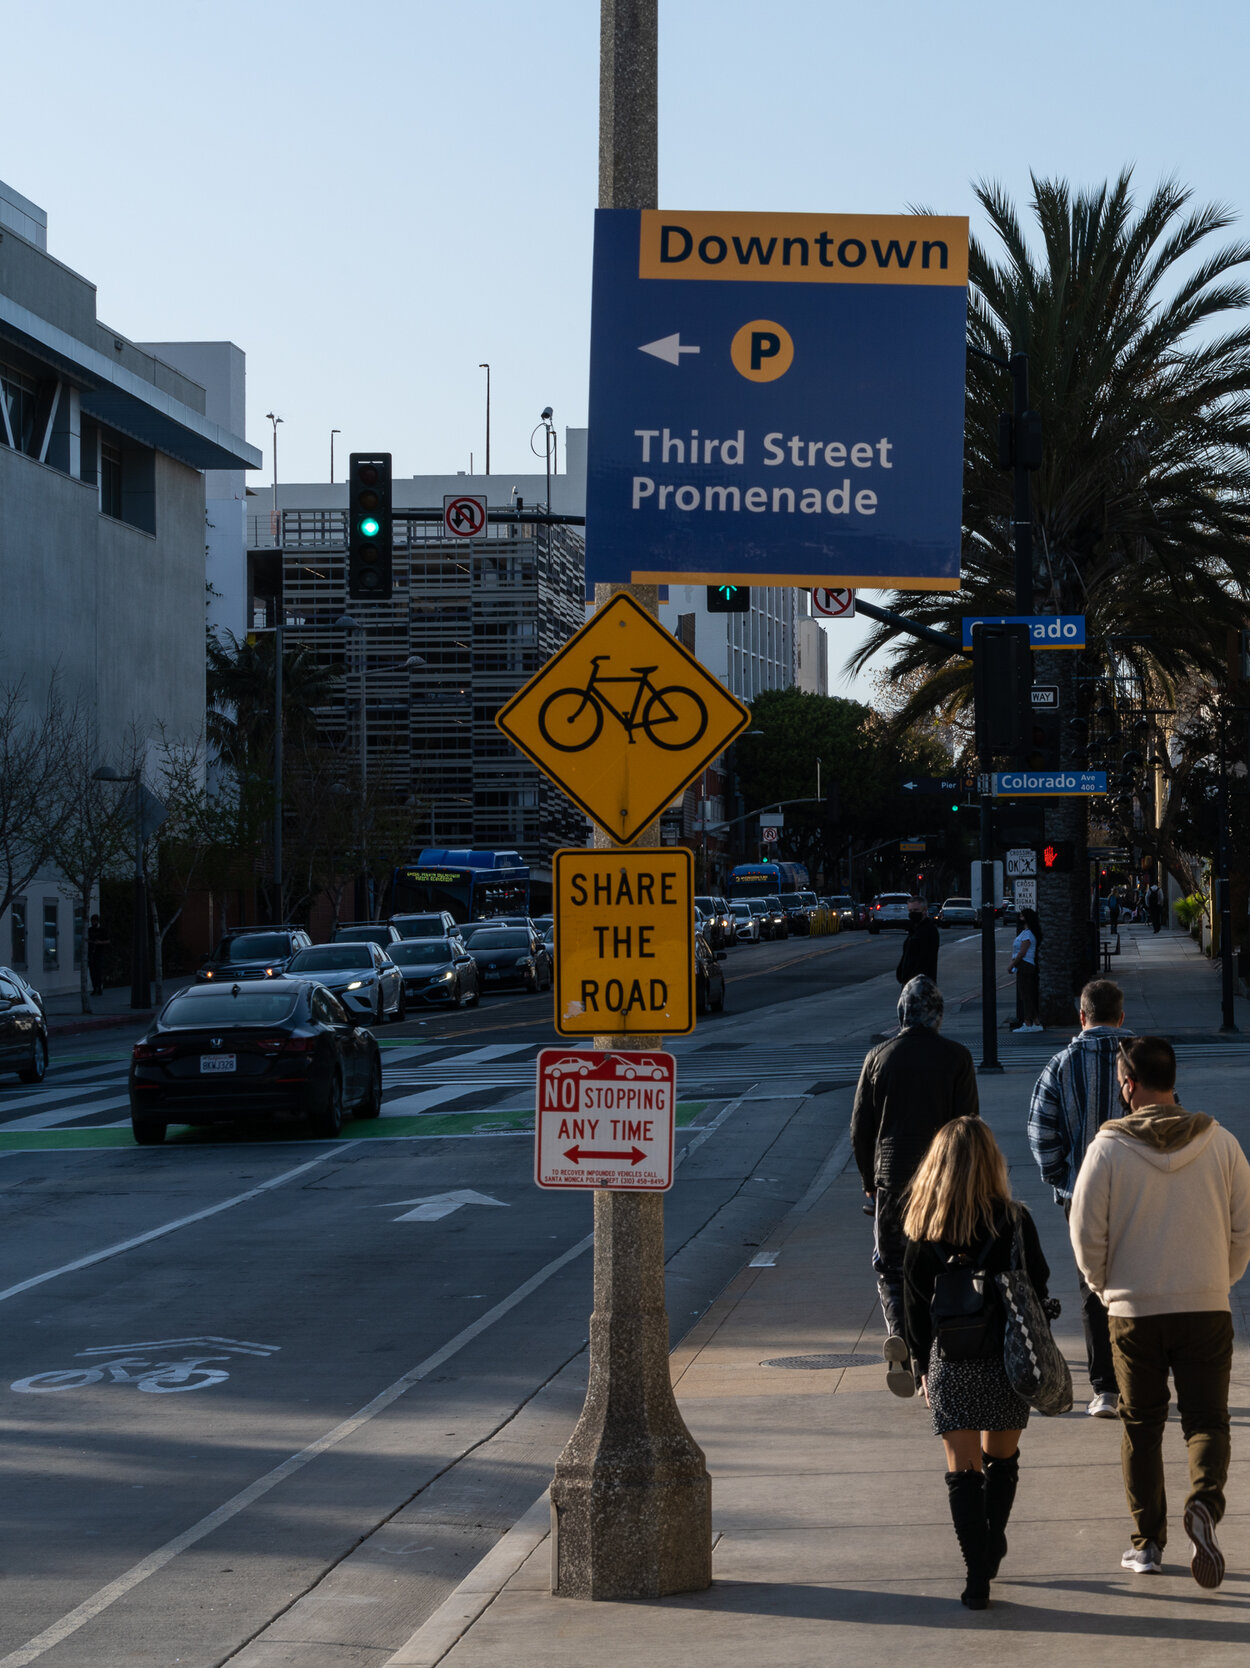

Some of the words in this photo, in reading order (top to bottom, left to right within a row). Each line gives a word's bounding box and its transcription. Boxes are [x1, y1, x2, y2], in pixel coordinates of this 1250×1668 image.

[659, 225, 949, 270] Downtown
[750, 331, 781, 370] P
[634, 428, 745, 465] Third
[763, 432, 893, 468] Street
[632, 476, 878, 514] Promenade
[1032, 693, 1051, 701] WAY
[941, 781, 957, 789] Pier
[1001, 773, 1076, 788] Colorado
[1008, 860, 1019, 872] OK
[570, 872, 677, 906] SHARE
[593, 925, 656, 958] THE
[581, 978, 668, 1012] ROAD
[545, 1078, 576, 1108] NO
[584, 1087, 665, 1110] STOPPING
[558, 1118, 600, 1139] ANY
[610, 1120, 654, 1141] TIME
